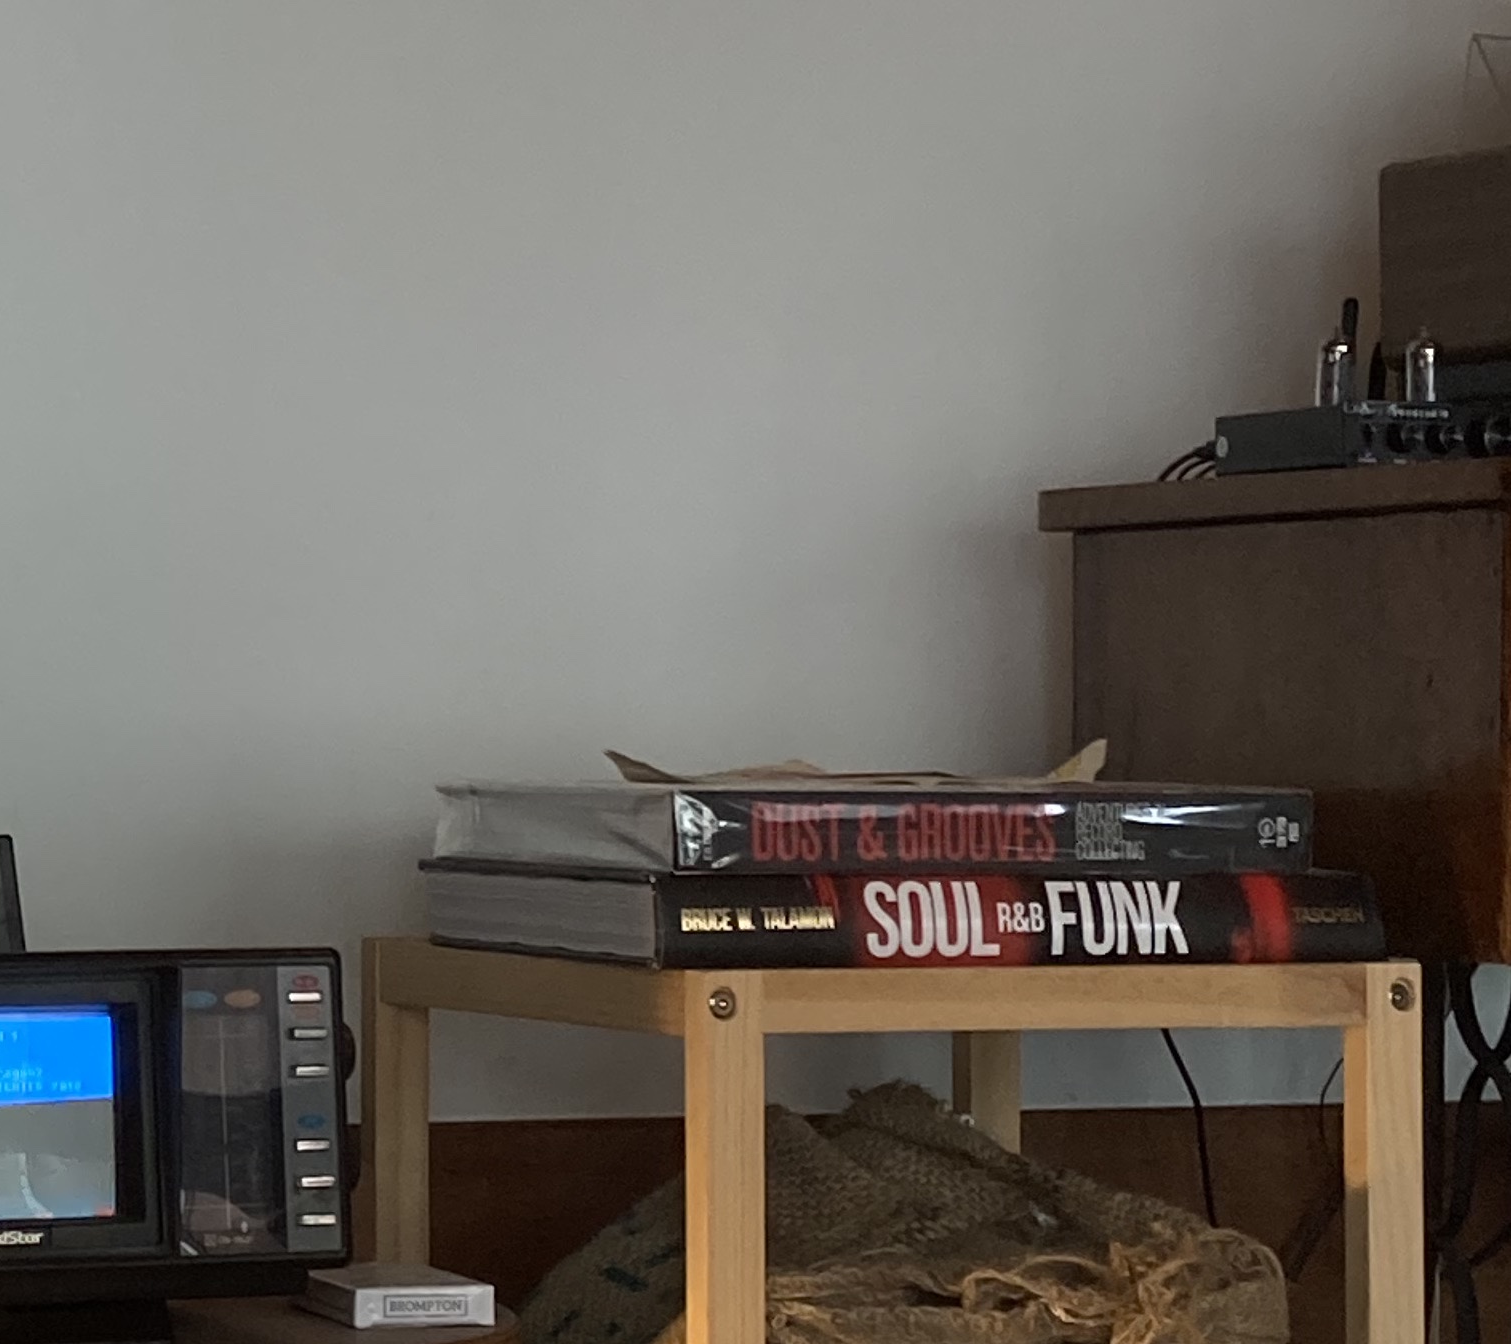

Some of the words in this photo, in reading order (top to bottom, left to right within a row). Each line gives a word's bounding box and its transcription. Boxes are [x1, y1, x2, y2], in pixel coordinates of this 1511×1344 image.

[751, 801, 841, 862] DUST
[856, 804, 887, 862] &
[897, 802, 1055, 862] GROOVES
[680, 907, 732, 932] BRUCE
[738, 907, 756, 931] W.
[760, 906, 836, 931] TALAMON
[863, 880, 1000, 959] SOUL
[997, 901, 1044, 934] R&B
[1044, 880, 1189, 956] FUNK
[1292, 906, 1364, 923] TASCHEN
[389, 1299, 463, 1313] BROMPTON
